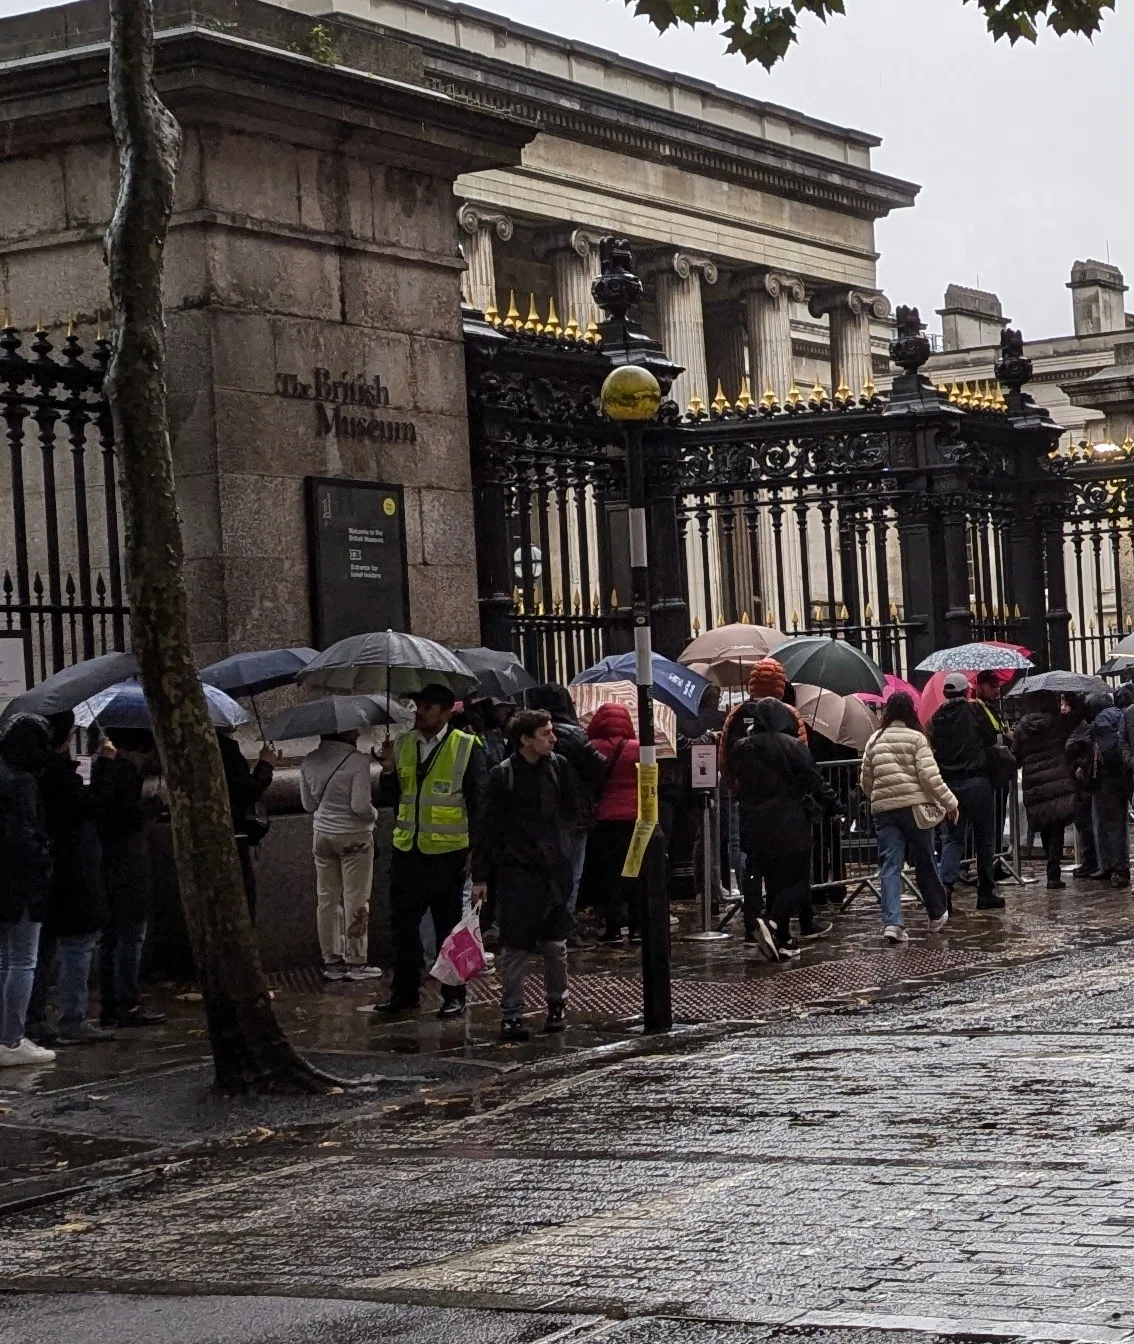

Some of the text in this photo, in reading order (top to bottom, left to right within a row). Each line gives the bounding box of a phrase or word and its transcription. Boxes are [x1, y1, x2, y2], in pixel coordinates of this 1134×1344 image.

[276, 367, 390, 405] The British
[315, 402, 417, 442] Museum
